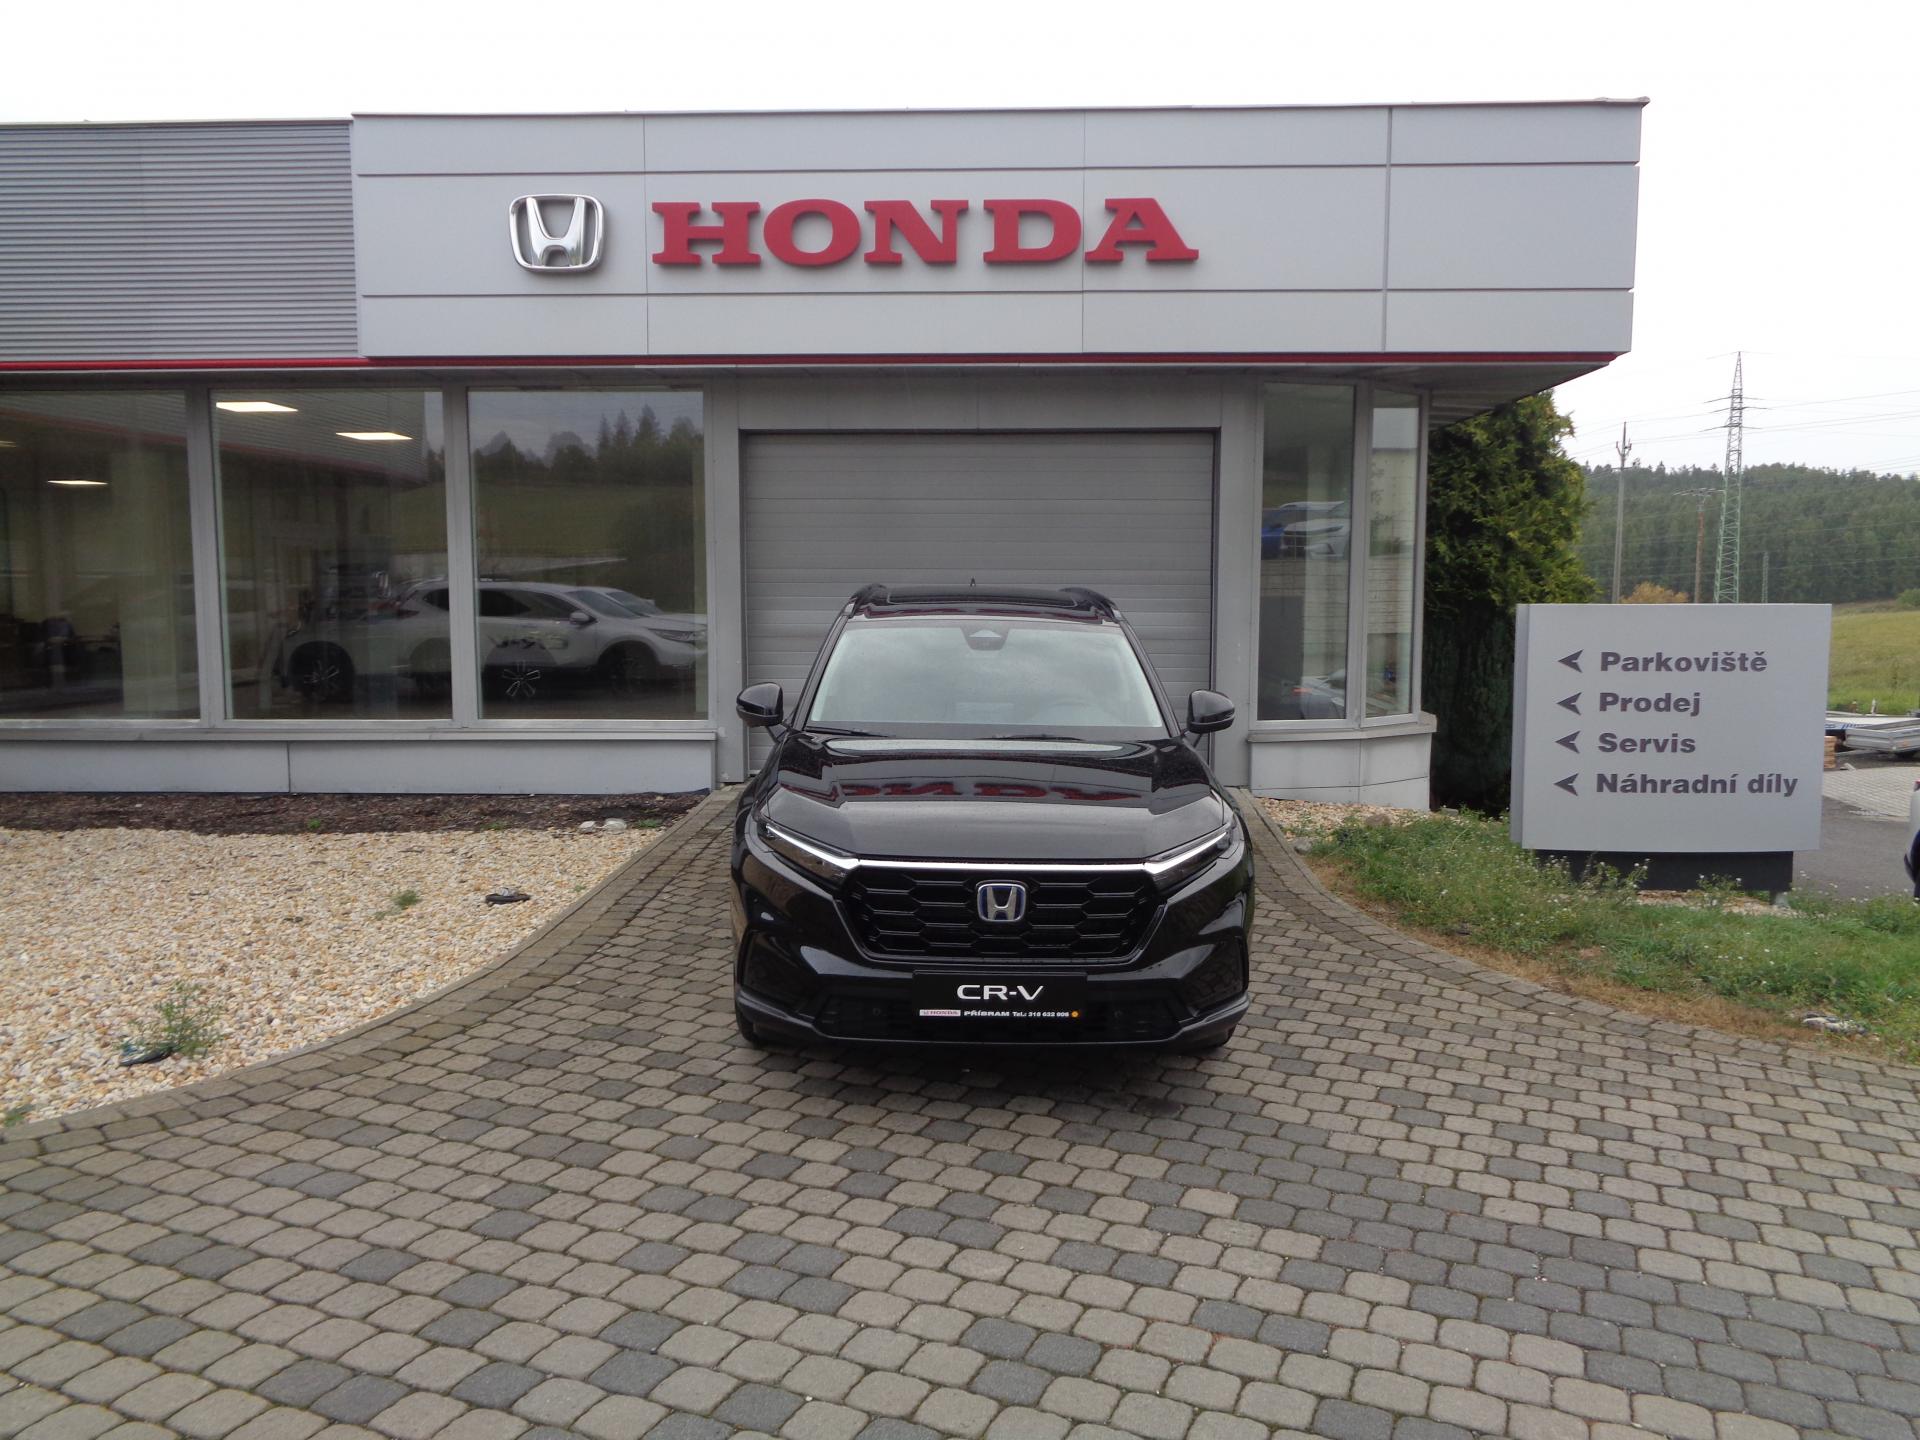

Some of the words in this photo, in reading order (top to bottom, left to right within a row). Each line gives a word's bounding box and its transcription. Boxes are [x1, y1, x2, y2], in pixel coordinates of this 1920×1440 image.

[652, 198, 1199, 266] HONDA
[1600, 651, 1768, 672] Parkoviště
[1599, 692, 1701, 717] Prodej
[1597, 732, 1696, 753] Servis
[1596, 773, 1739, 794] Náhradní
[1747, 773, 1799, 797] díly
[956, 984, 1044, 1001] CR-V
[963, 1009, 1010, 1017] PŘÍBRAM
